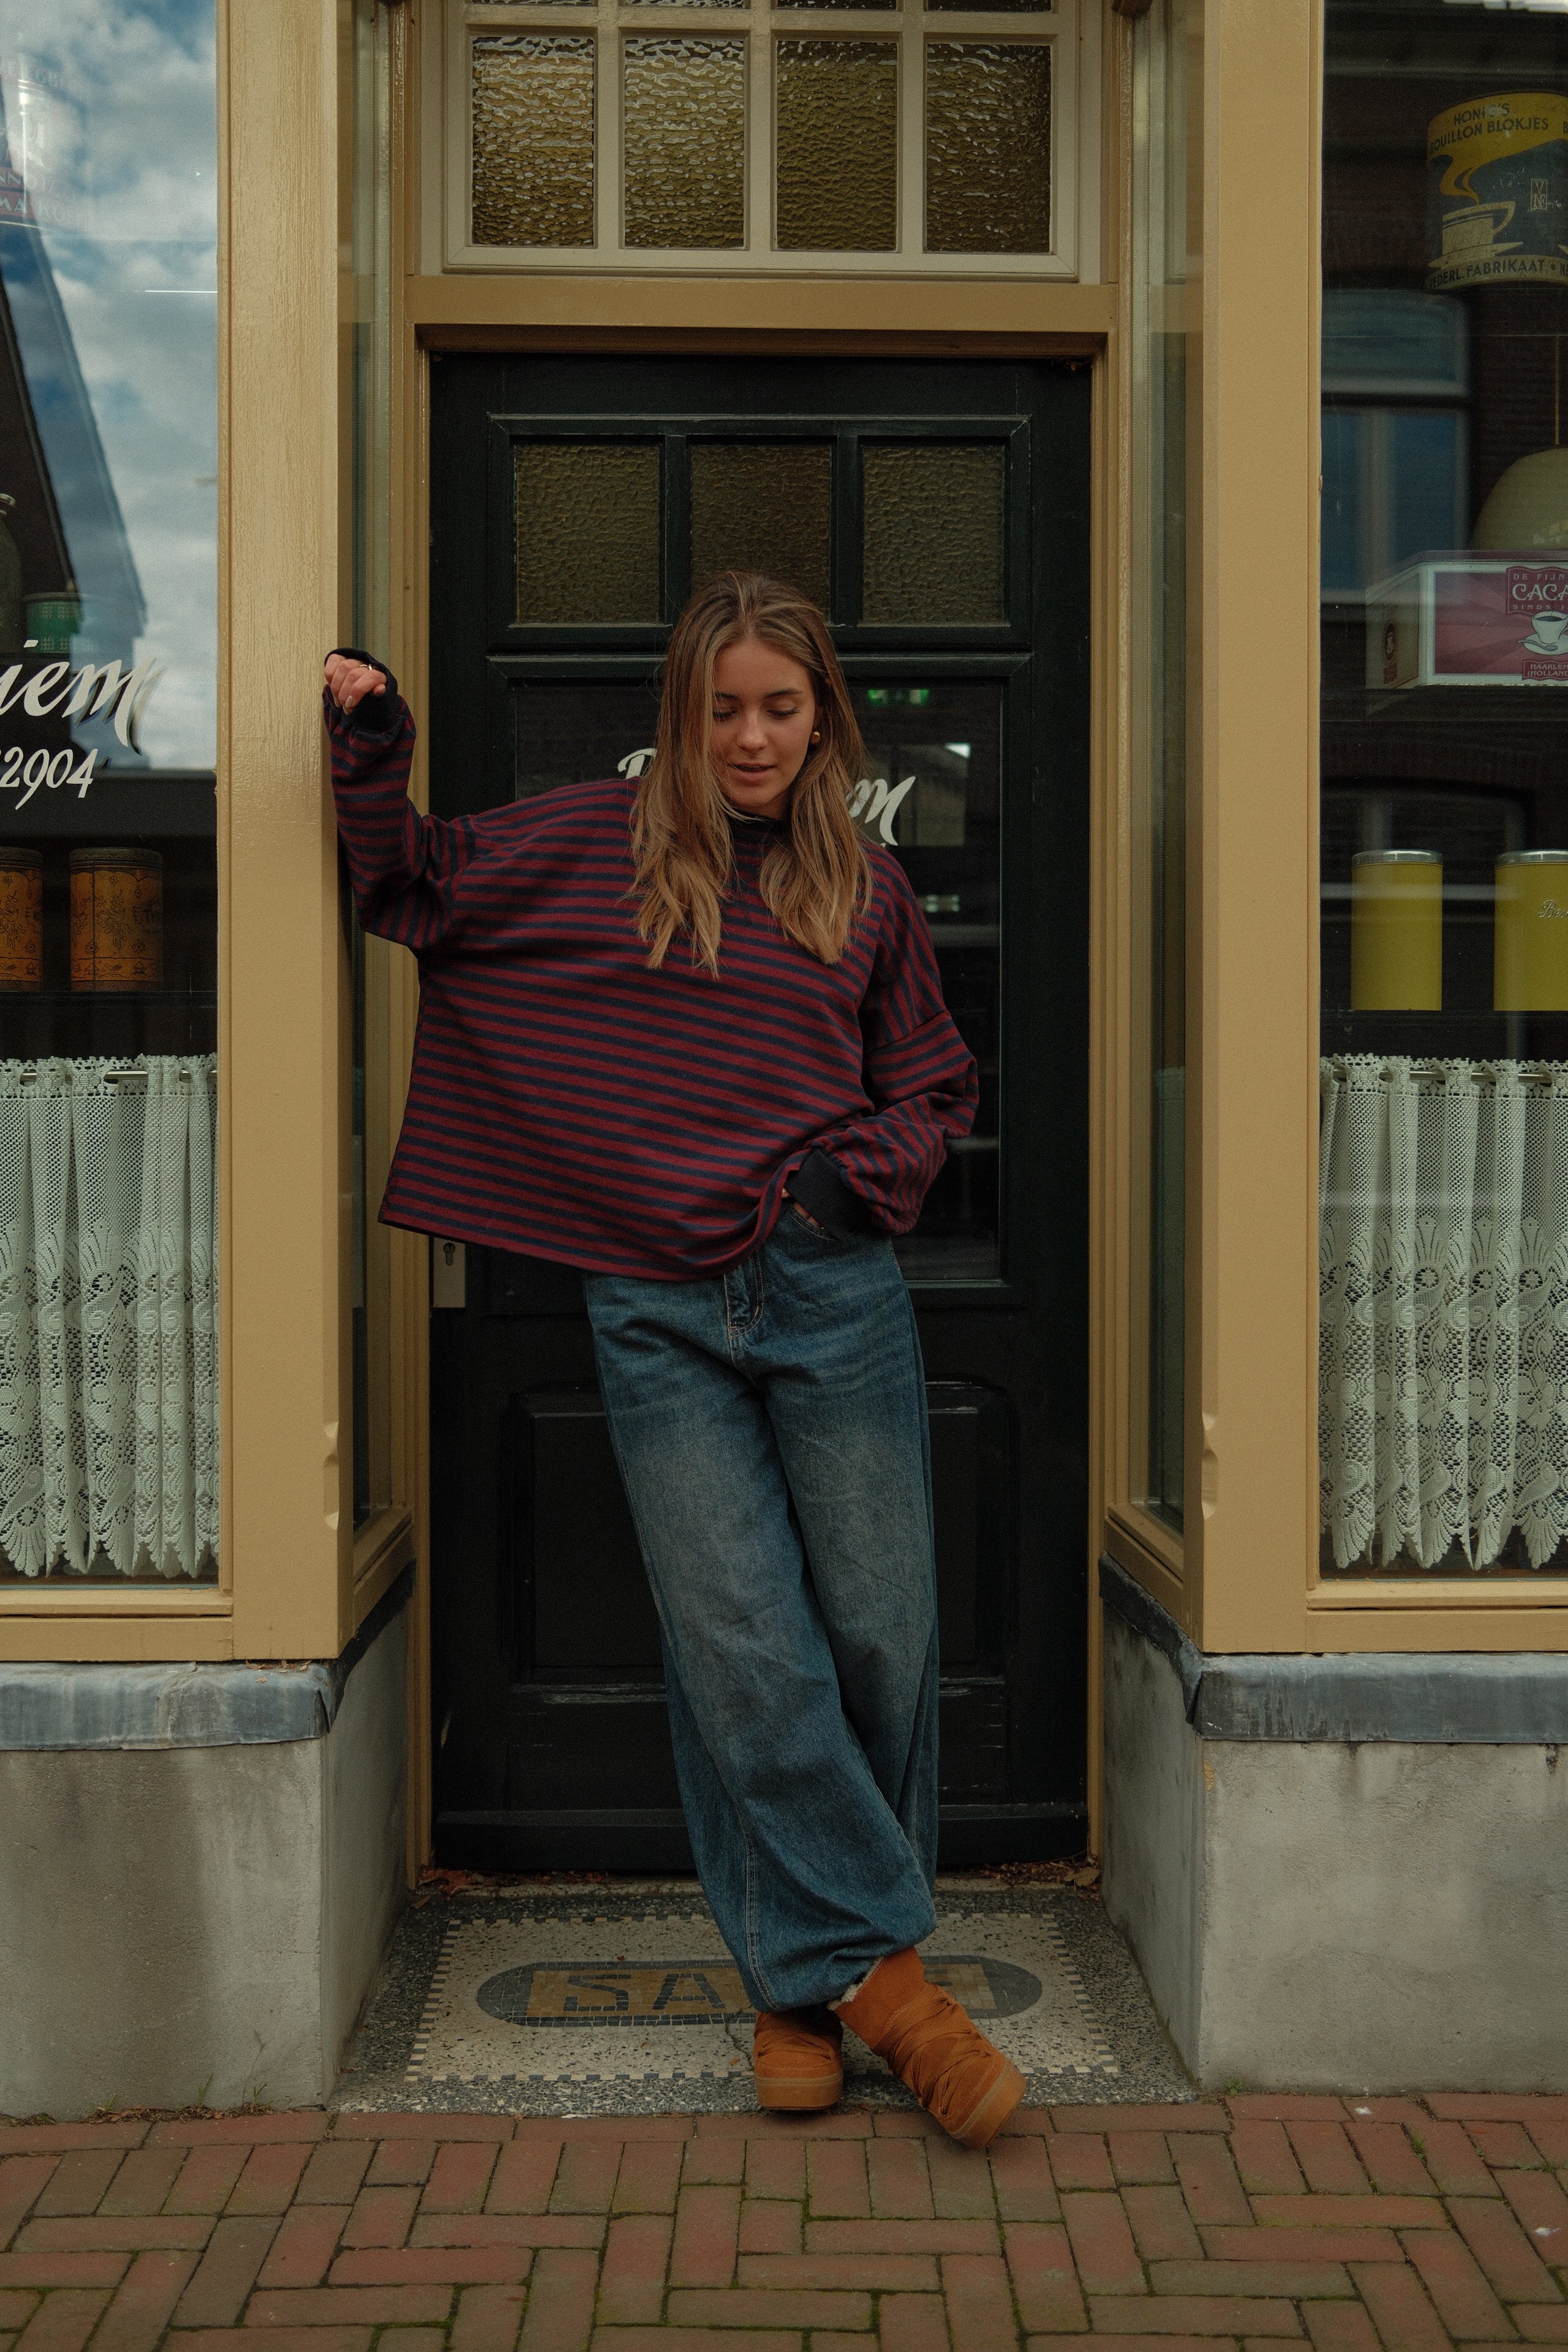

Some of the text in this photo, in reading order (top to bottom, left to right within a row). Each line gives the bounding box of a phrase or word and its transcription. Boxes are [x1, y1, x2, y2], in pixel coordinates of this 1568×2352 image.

[1429, 118, 1548, 154] BOUILLON BLOKJES
[1466, 259, 1545, 277] FABRIKAAT
[0, 746, 98, 810] 2904
